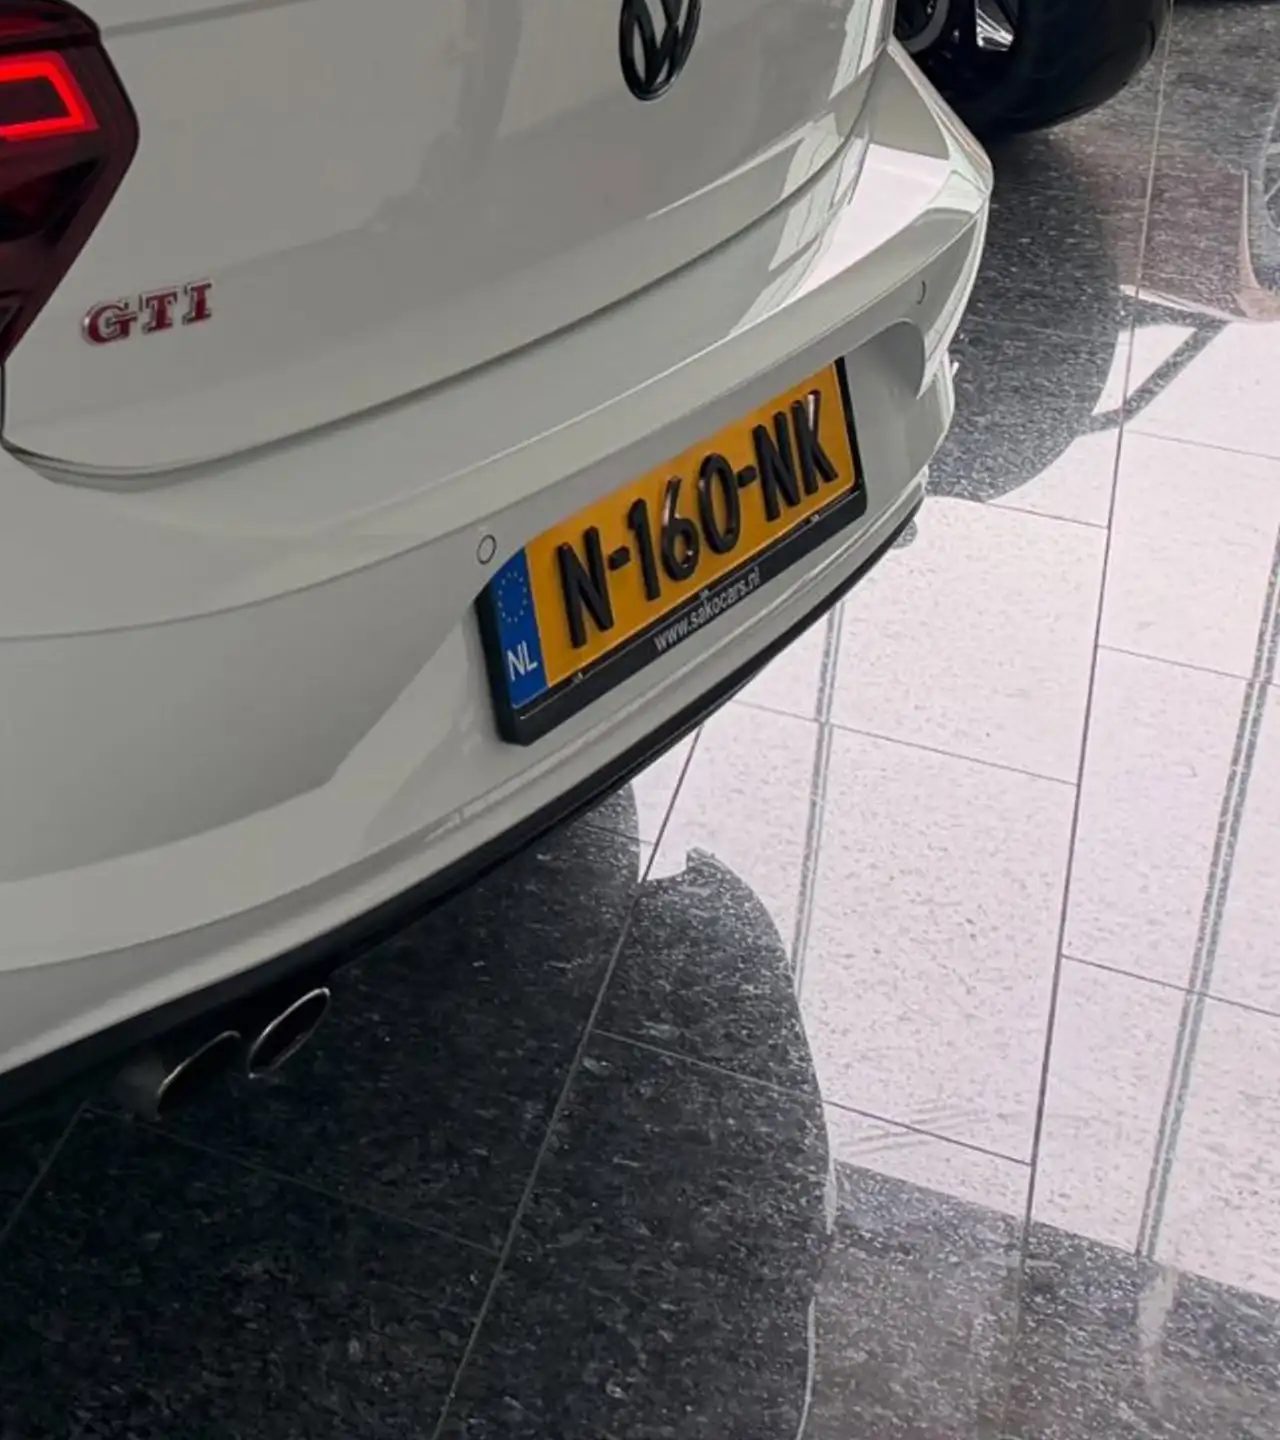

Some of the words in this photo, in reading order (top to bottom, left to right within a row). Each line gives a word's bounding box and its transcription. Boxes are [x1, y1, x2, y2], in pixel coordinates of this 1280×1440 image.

[81, 279, 213, 345] GTI
[556, 389, 839, 650] N-160-NK
[653, 565, 761, 653] www.sakocars.nl
[505, 640, 539, 682] NL
